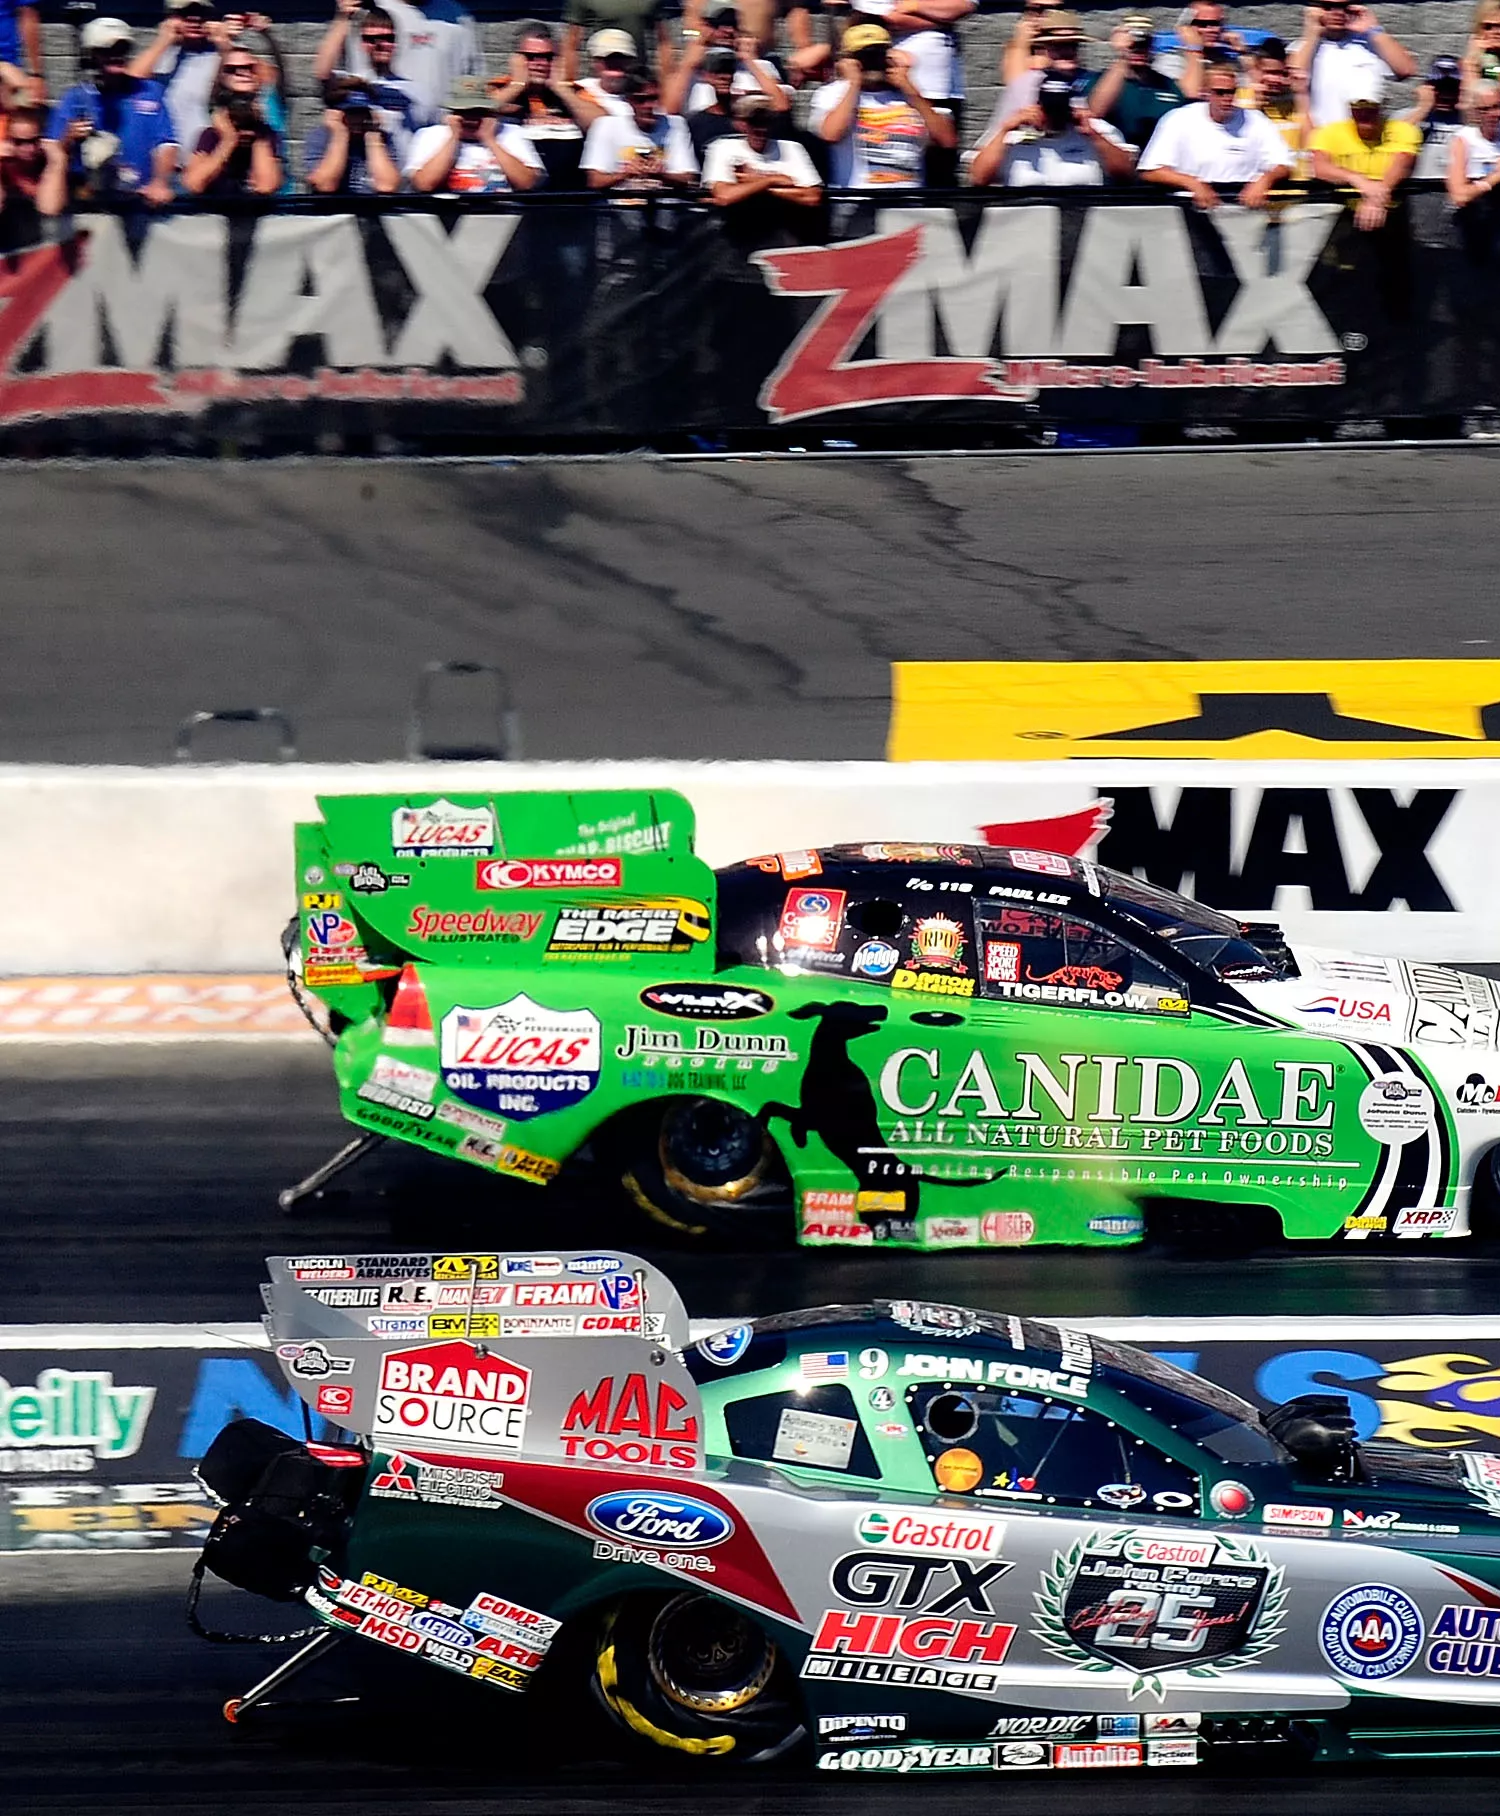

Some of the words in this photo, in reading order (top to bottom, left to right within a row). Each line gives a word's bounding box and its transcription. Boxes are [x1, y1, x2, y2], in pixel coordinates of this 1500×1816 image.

[404, 825, 486, 844] LUCAS
[533, 863, 617, 881] KYMCO
[989, 887, 1034, 900] PAUL
[1037, 893, 1071, 906] LEE
[408, 907, 544, 940] Speedway
[561, 909, 599, 919] THE
[603, 909, 680, 920] RACERS
[309, 912, 340, 945] VP
[427, 933, 520, 944] ILLUSTRATED
[553, 919, 676, 942] EDGE
[924, 931, 952, 948] RPO
[852, 949, 900, 971] pledge
[987, 945, 1018, 957] SPEED
[987, 957, 1017, 969] SPORT
[987, 969, 1017, 981] NEWS
[998, 982, 1148, 1009] TIGERFLOW
[1339, 999, 1391, 1021] USA
[457, 1036, 590, 1066] LUCAS
[617, 1026, 681, 1057] Jim
[697, 1027, 787, 1052] Dunn
[446, 1073, 481, 1089] OIL
[487, 1074, 590, 1091] PRODUCTS
[879, 1046, 1335, 1127] CANIDAE
[499, 1094, 539, 1112] INC.
[888, 1122, 955, 1145] ALL
[966, 1124, 1129, 1150] NATURAL
[1140, 1128, 1208, 1152] PET
[1217, 1131, 1334, 1157] FOODS
[1008, 1163, 1157, 1183] Responsible
[1172, 1168, 1208, 1183] Pet
[1223, 1171, 1348, 1193] Ownership
[805, 1192, 854, 1205] FRAM
[1400, 1211, 1444, 1224] XRP
[803, 1224, 871, 1237] ARP
[288, 1259, 343, 1269] LINCOLN
[356, 1257, 427, 1267] STANDARD
[357, 1268, 430, 1278] ABRASIVES
[516, 1285, 596, 1305] FRAM
[601, 1276, 633, 1309] VP
[582, 1316, 641, 1330] COMP
[858, 1348, 889, 1379] 9
[384, 1362, 526, 1401] BRAND
[897, 1354, 982, 1379] JOHN
[988, 1360, 1092, 1398] FORCE
[562, 1374, 698, 1442] MAC
[871, 1390, 891, 1407] 4
[0, 1374, 150, 1454] eilly
[378, 1396, 522, 1438] SOURCE
[560, 1436, 697, 1468] TOOLS
[420, 1467, 504, 1487] MITSUBISHI
[420, 1481, 490, 1500] ELECTRIC
[616, 1500, 704, 1540] Ford
[1270, 1508, 1325, 1521] SIMPSON
[886, 1517, 994, 1552] Castrol
[594, 1540, 660, 1565] Drive
[664, 1553, 715, 1572] one.
[1146, 1543, 1207, 1564] Castrol
[832, 1551, 1014, 1615] GTX
[1080, 1561, 1158, 1582] John
[1163, 1566, 1257, 1588] Force
[1124, 1580, 1201, 1598] racing
[478, 1597, 539, 1624] COMP
[1331, 1589, 1398, 1621] AUTOMOBILE
[1393, 1600, 1417, 1627] CLUB
[411, 1616, 470, 1646] CLEVITE
[1095, 1589, 1216, 1653] 25
[1349, 1619, 1394, 1643] AAA
[362, 1618, 420, 1649] MSD
[814, 1611, 1017, 1665] HIGH
[426, 1641, 473, 1667] WELD
[1325, 1626, 1365, 1675] SOUTHERN
[1365, 1633, 1418, 1676] CALIFORNIA
[806, 1657, 998, 1692] MILEAGE
[993, 1716, 1092, 1738] NORDIC
[820, 1746, 991, 1771] GOODYEAR
[1060, 1745, 1140, 1766] Autolite
